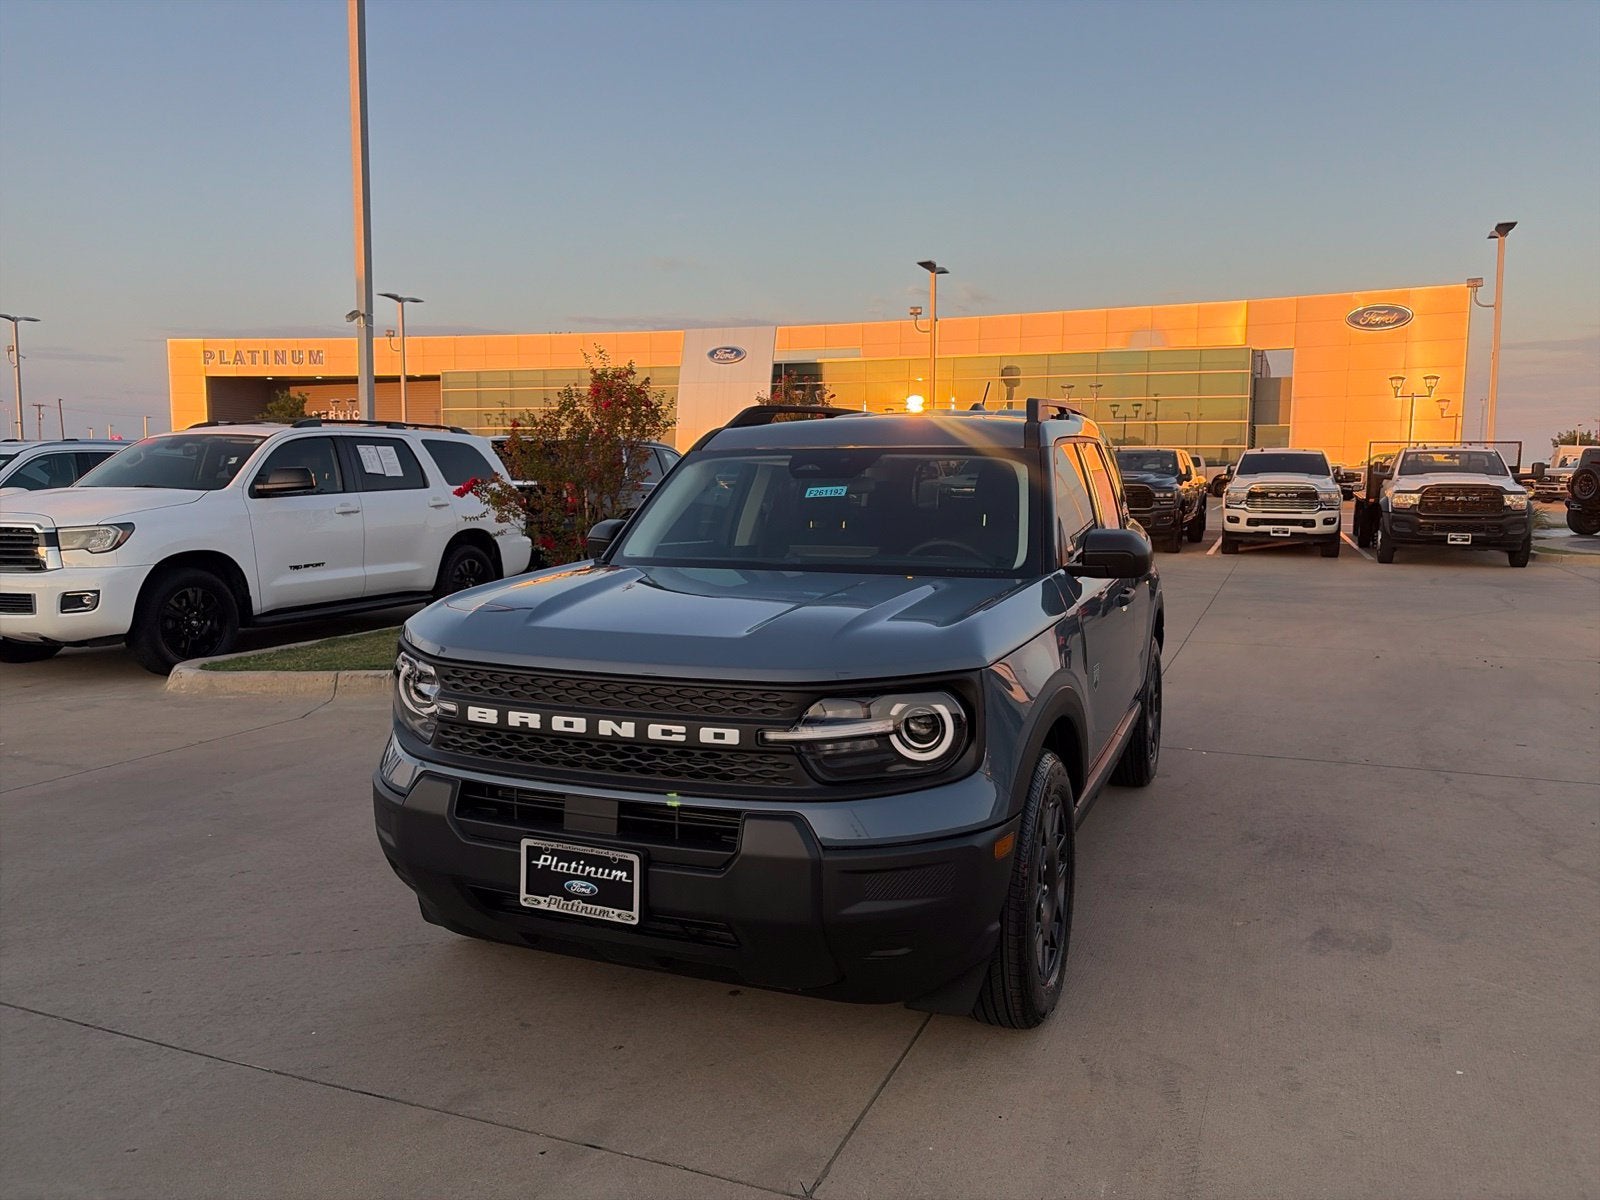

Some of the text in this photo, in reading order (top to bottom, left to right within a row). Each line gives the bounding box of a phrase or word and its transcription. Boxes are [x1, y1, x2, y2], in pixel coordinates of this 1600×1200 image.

[1360, 310, 1398, 325] Ford
[203, 350, 324, 365] PLATINUM
[808, 488, 845, 497] F261192
[303, 561, 326, 569] SPORT
[467, 705, 740, 745] BRONCO
[531, 854, 633, 883] Platinum
[546, 896, 611, 918] Platinum
